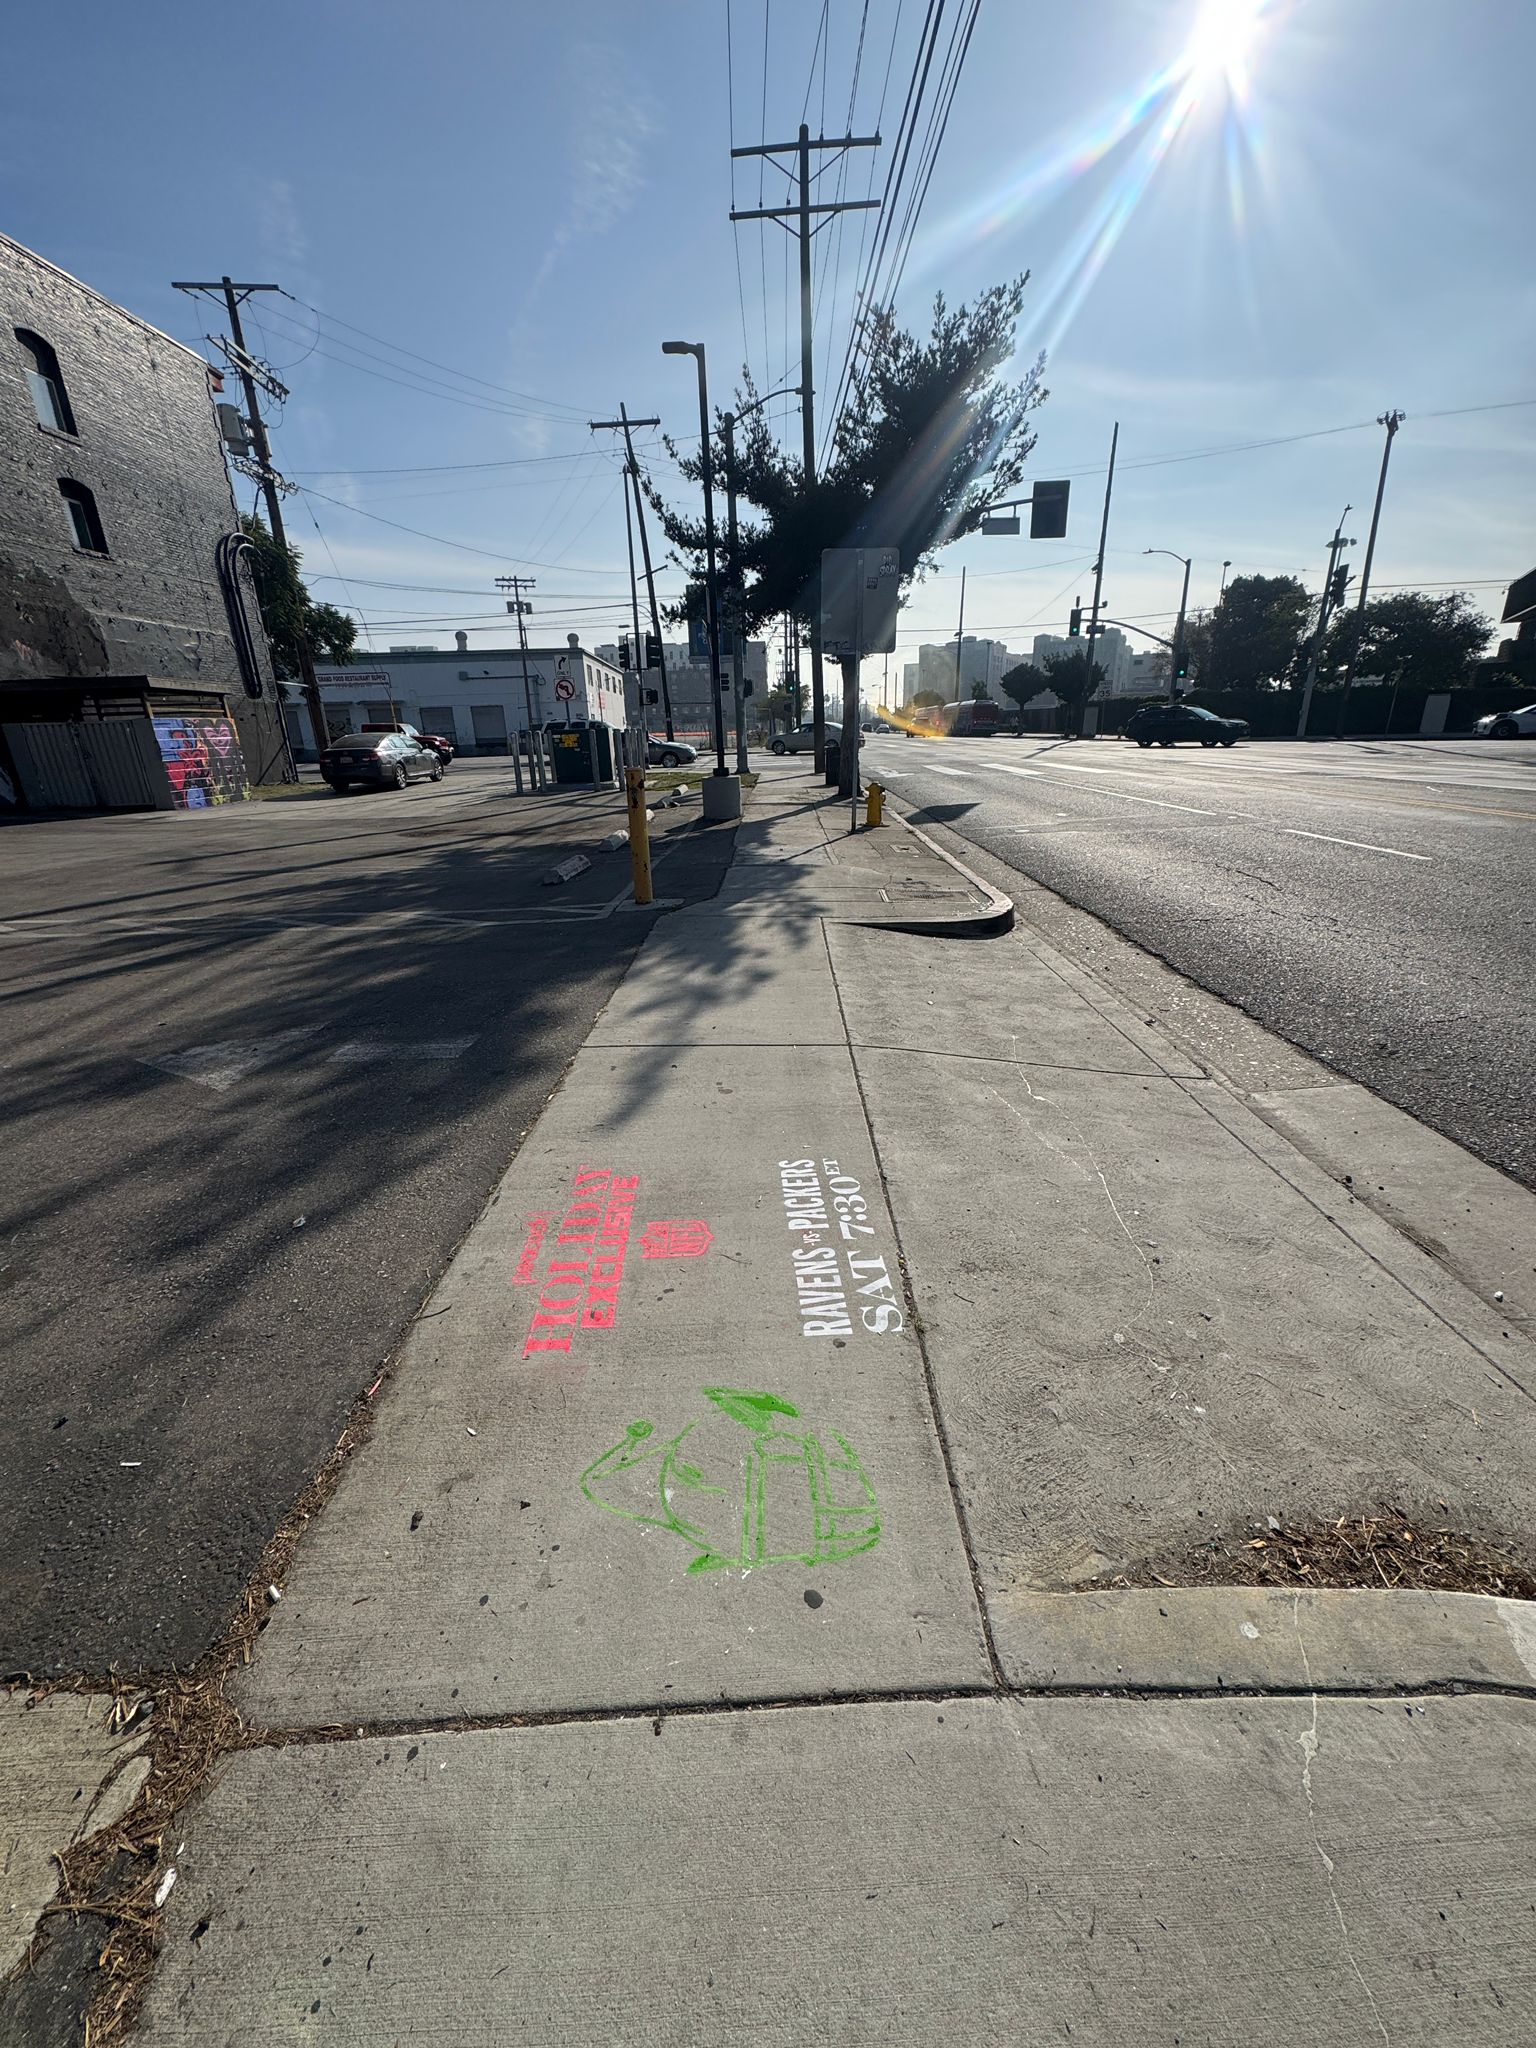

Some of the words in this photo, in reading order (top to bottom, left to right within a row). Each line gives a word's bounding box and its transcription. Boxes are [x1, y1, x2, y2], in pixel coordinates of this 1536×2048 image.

[1100, 689, 1111, 697] 35
[778, 1159, 830, 1230] PACKERS
[512, 1217, 549, 1286] peacock
[522, 1163, 612, 1359] HOLIDAY
[580, 1174, 640, 1328] EXCLUSIVE
[669, 1222, 705, 1255] NFL
[791, 1247, 853, 1337] RAVENS
[847, 1250, 904, 1334] SAT
